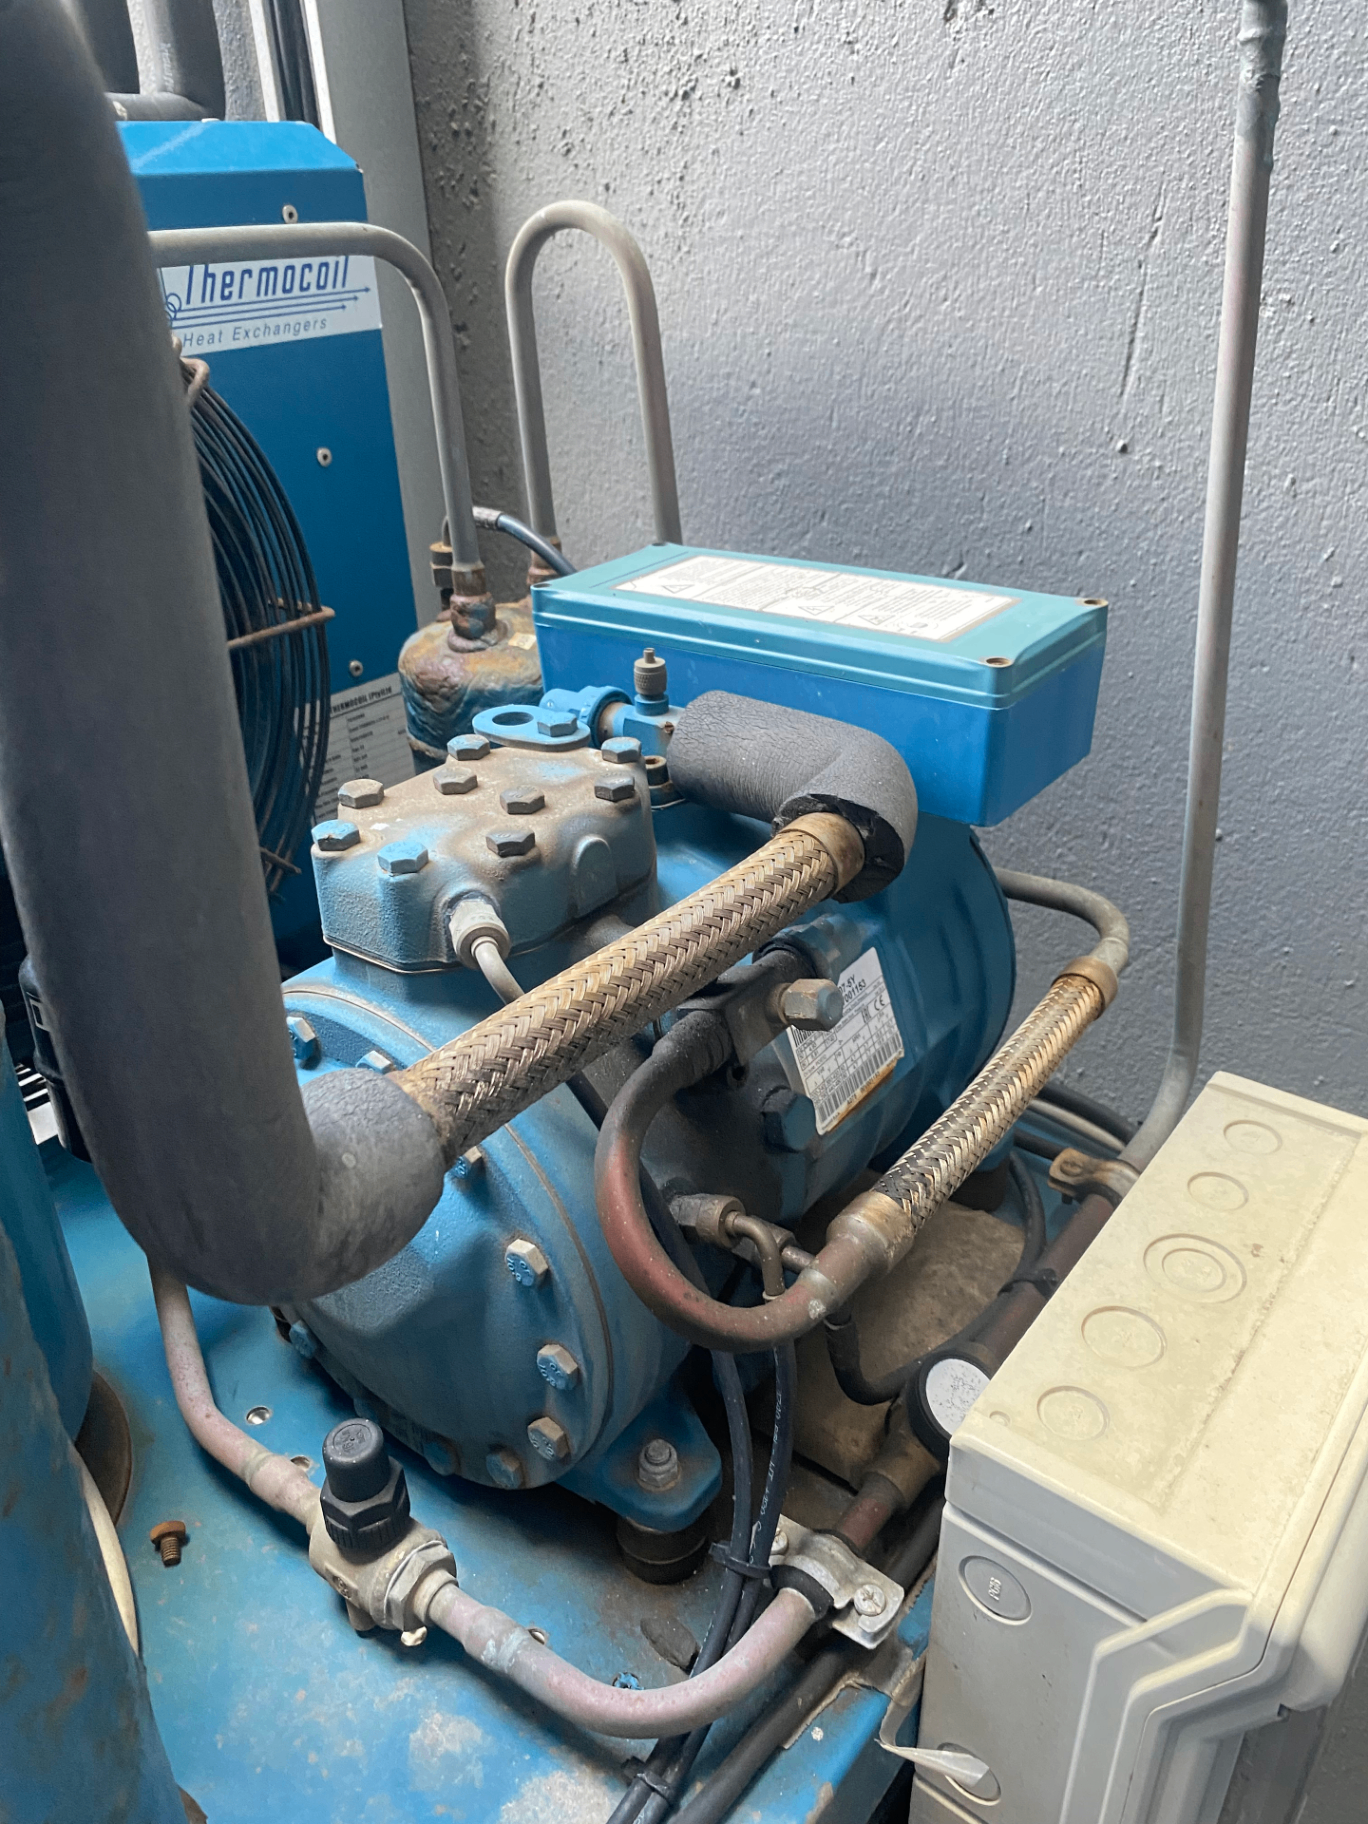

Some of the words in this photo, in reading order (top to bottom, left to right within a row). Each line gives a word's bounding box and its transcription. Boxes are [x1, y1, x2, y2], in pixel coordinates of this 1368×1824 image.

[183, 331, 224, 348] Heat
[233, 317, 328, 342] Exchangers
[330, 693, 368, 714] HERMOCOIL
[843, 978, 867, 1003] 001153
